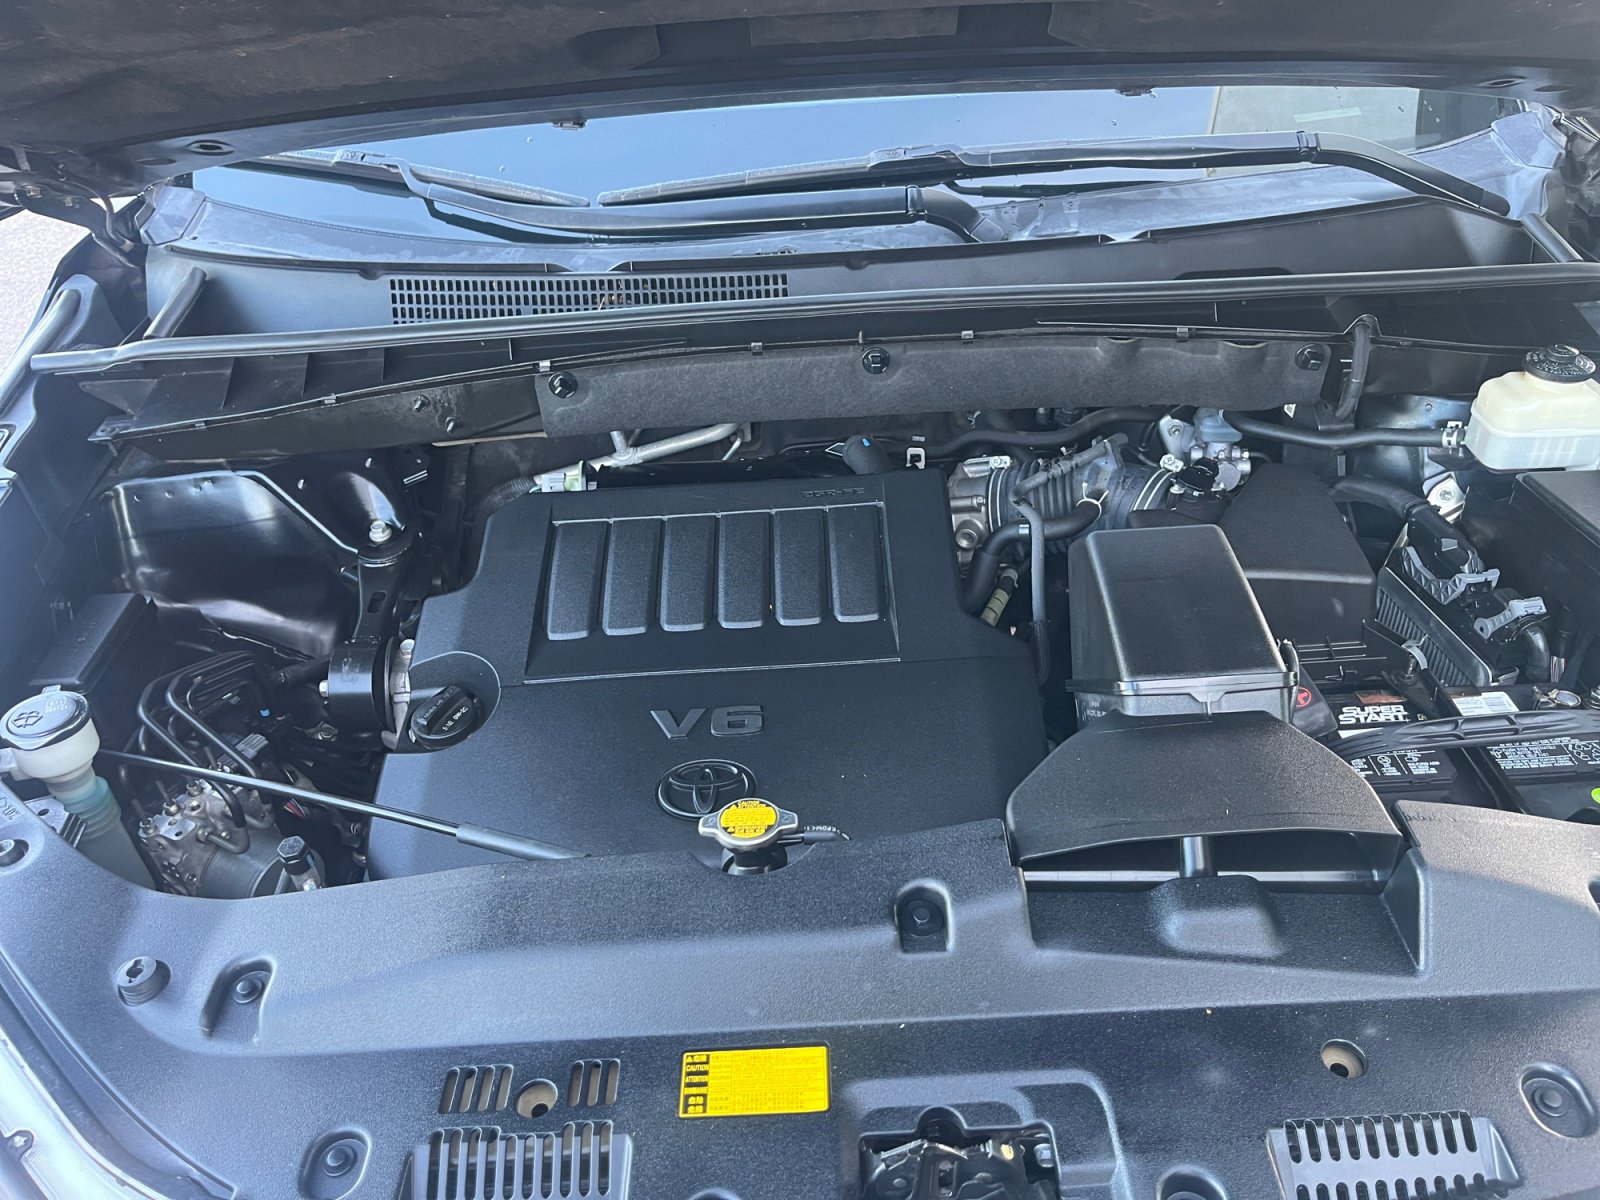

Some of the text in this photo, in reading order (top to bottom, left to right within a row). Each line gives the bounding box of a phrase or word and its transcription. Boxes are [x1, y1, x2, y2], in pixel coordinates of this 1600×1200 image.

[1341, 704, 1406, 715] SUPER
[650, 705, 764, 739] V6
[1338, 713, 1408, 724] START
[686, 1064, 710, 1072] CAUTION
